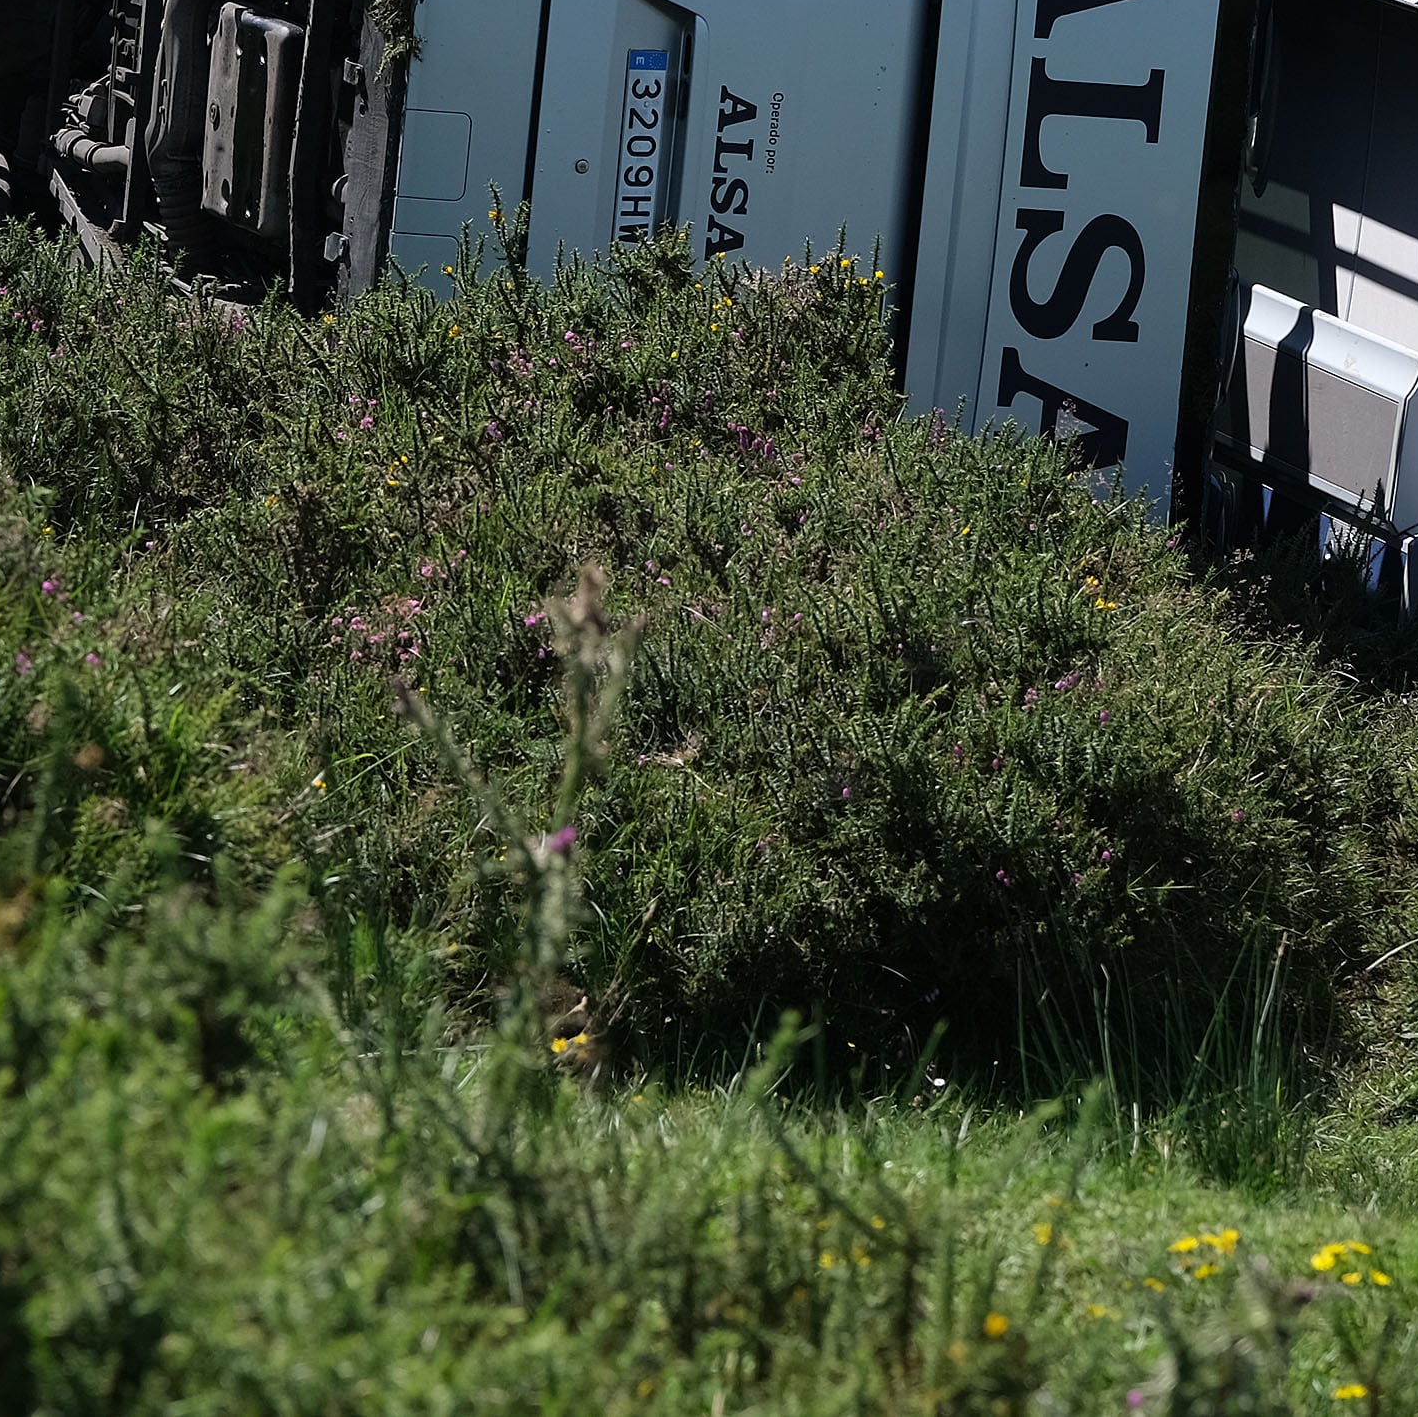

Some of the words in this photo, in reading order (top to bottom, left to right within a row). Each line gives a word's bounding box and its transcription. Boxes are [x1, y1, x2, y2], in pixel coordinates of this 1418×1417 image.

[769, 91, 784, 146] Operado
[703, 84, 759, 262] ALSA
[765, 148, 776, 174] por:
